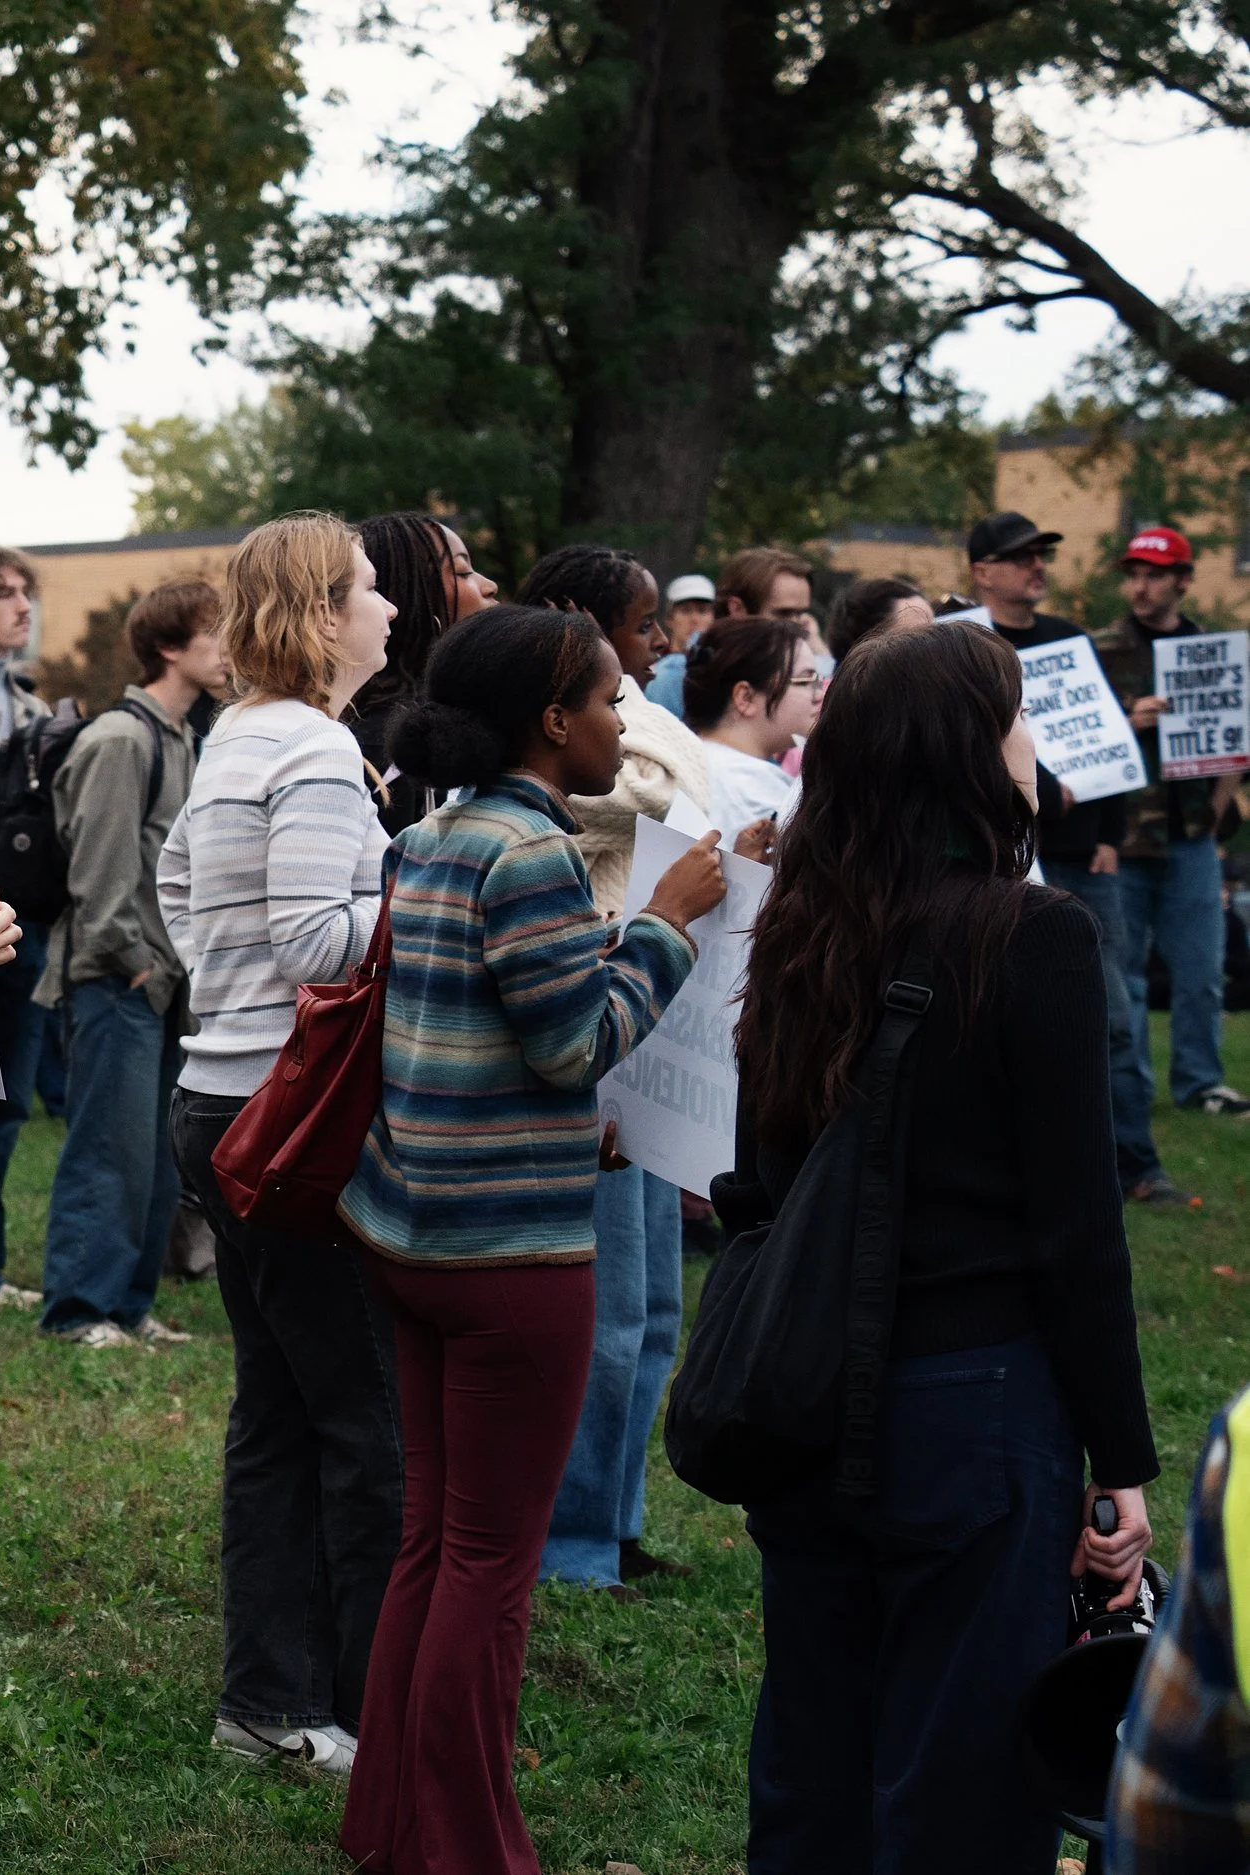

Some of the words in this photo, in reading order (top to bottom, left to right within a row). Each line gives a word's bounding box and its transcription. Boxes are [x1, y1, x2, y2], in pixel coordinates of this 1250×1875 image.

[1022, 651, 1078, 680] JUSTICE
[1177, 639, 1228, 666] FIGHT
[1164, 664, 1243, 691] TRUMP'S
[1027, 697, 1063, 717] JANE
[1043, 711, 1105, 743] JUSTICE
[1167, 729, 1216, 757] TITLE
